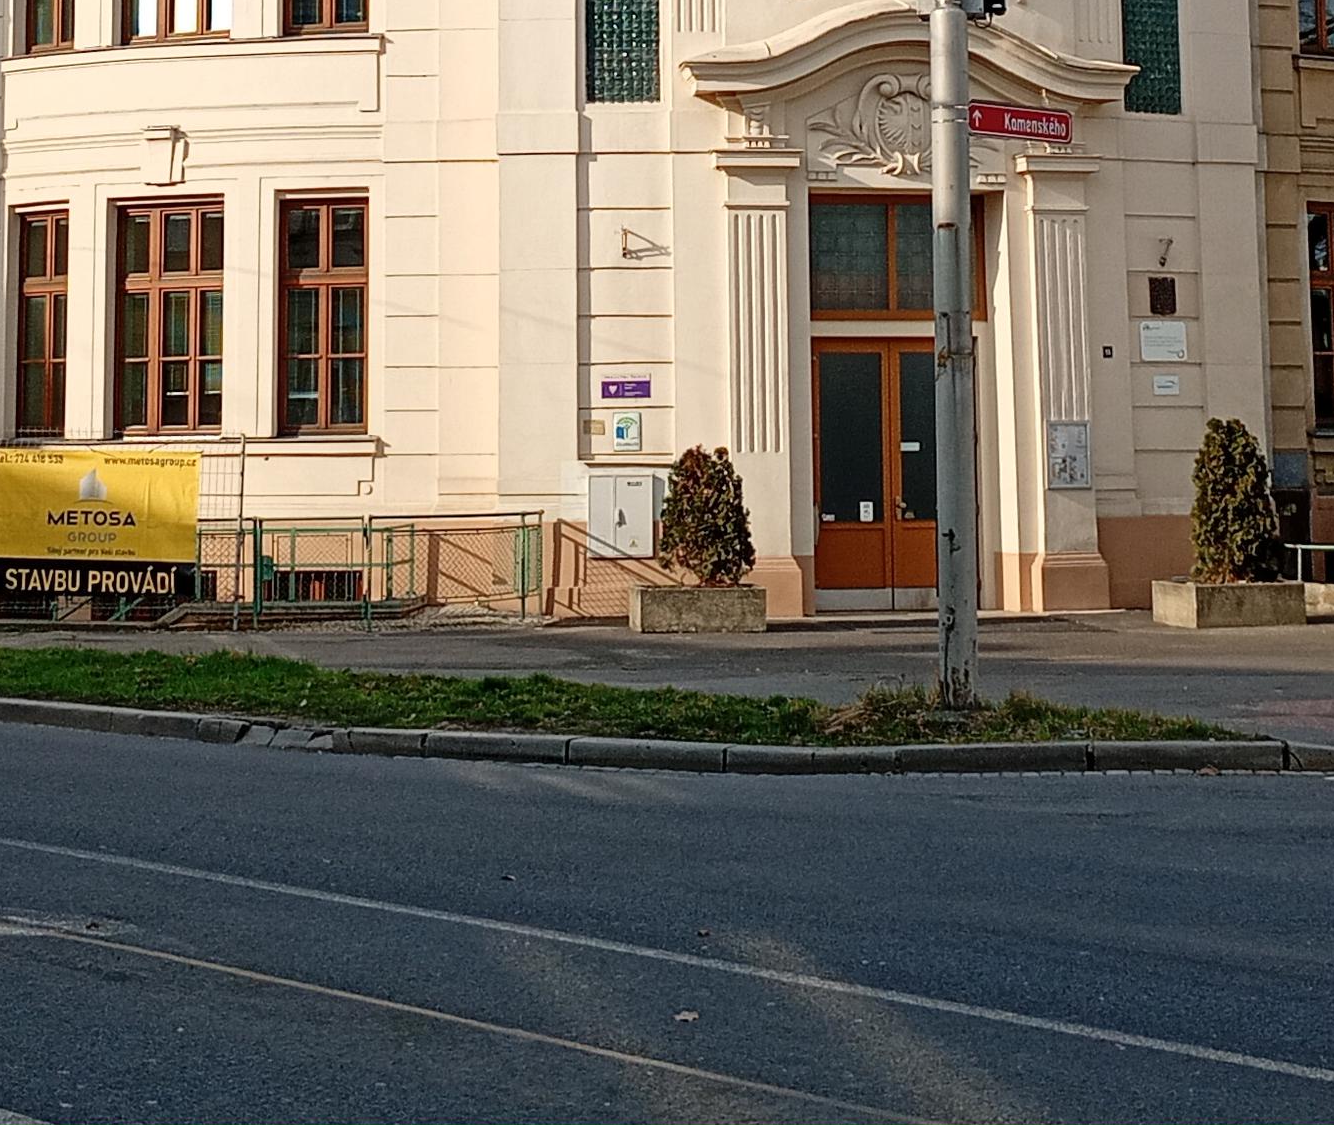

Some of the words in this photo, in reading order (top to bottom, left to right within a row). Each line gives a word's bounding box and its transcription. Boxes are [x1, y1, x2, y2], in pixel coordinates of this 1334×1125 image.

[1004, 112, 1066, 136] Kamenského
[104, 457, 197, 468] www.metosagroup.cz
[47, 510, 136, 526] METOSA
[67, 531, 117, 543] GROUP
[5, 568, 80, 592] STAVBU
[87, 565, 178, 594] PROVÁDÍ
